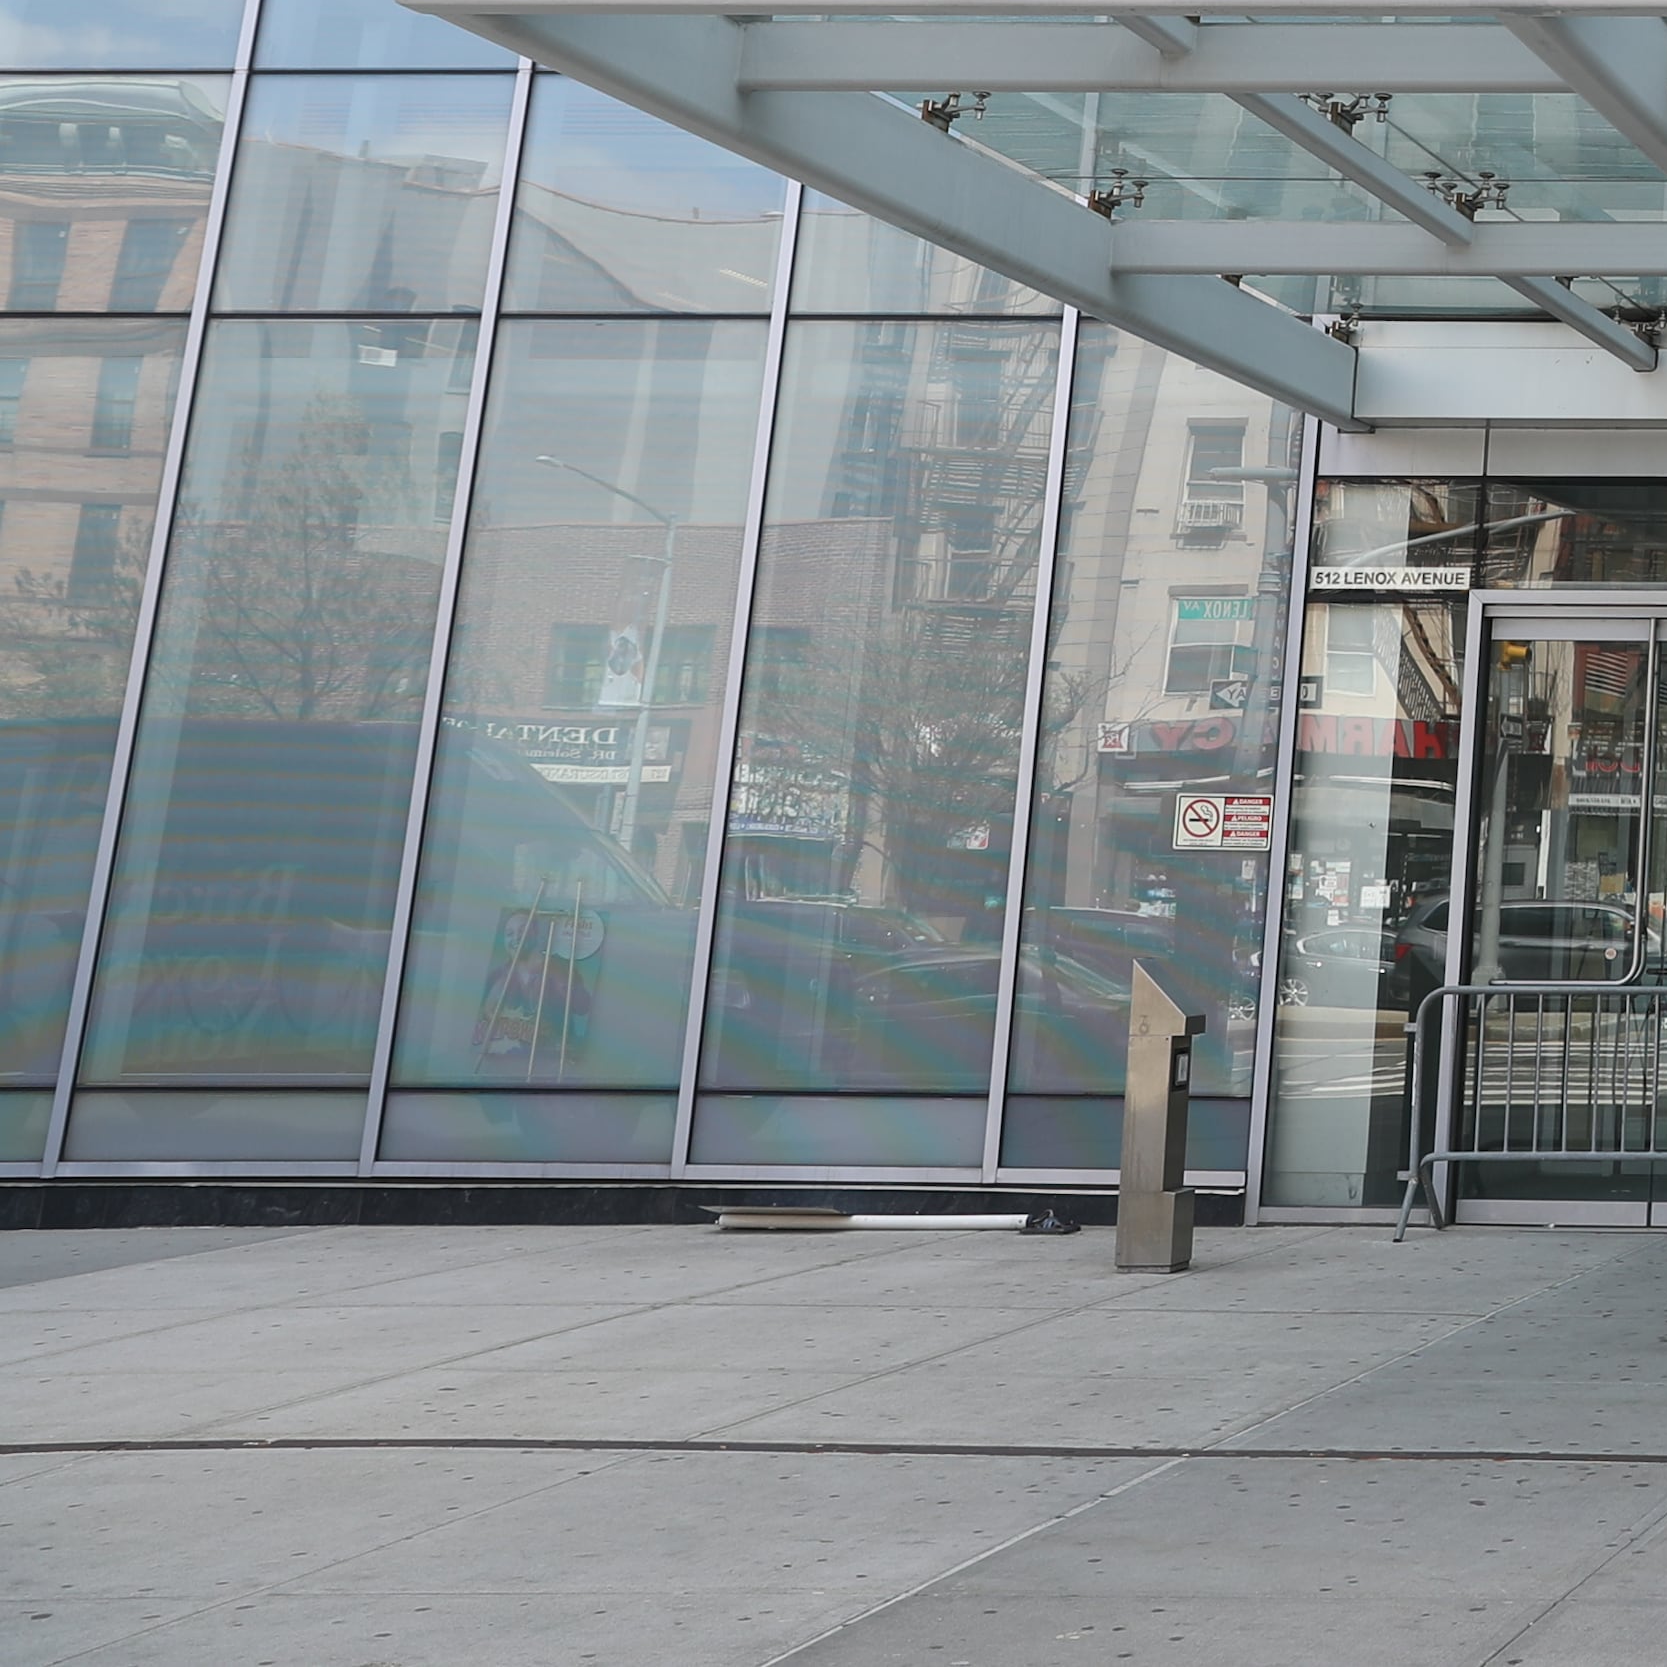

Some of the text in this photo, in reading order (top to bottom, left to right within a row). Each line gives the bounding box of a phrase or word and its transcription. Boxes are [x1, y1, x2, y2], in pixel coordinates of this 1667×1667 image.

[1315, 572, 1465, 585] 512 LENOX AVENUE
